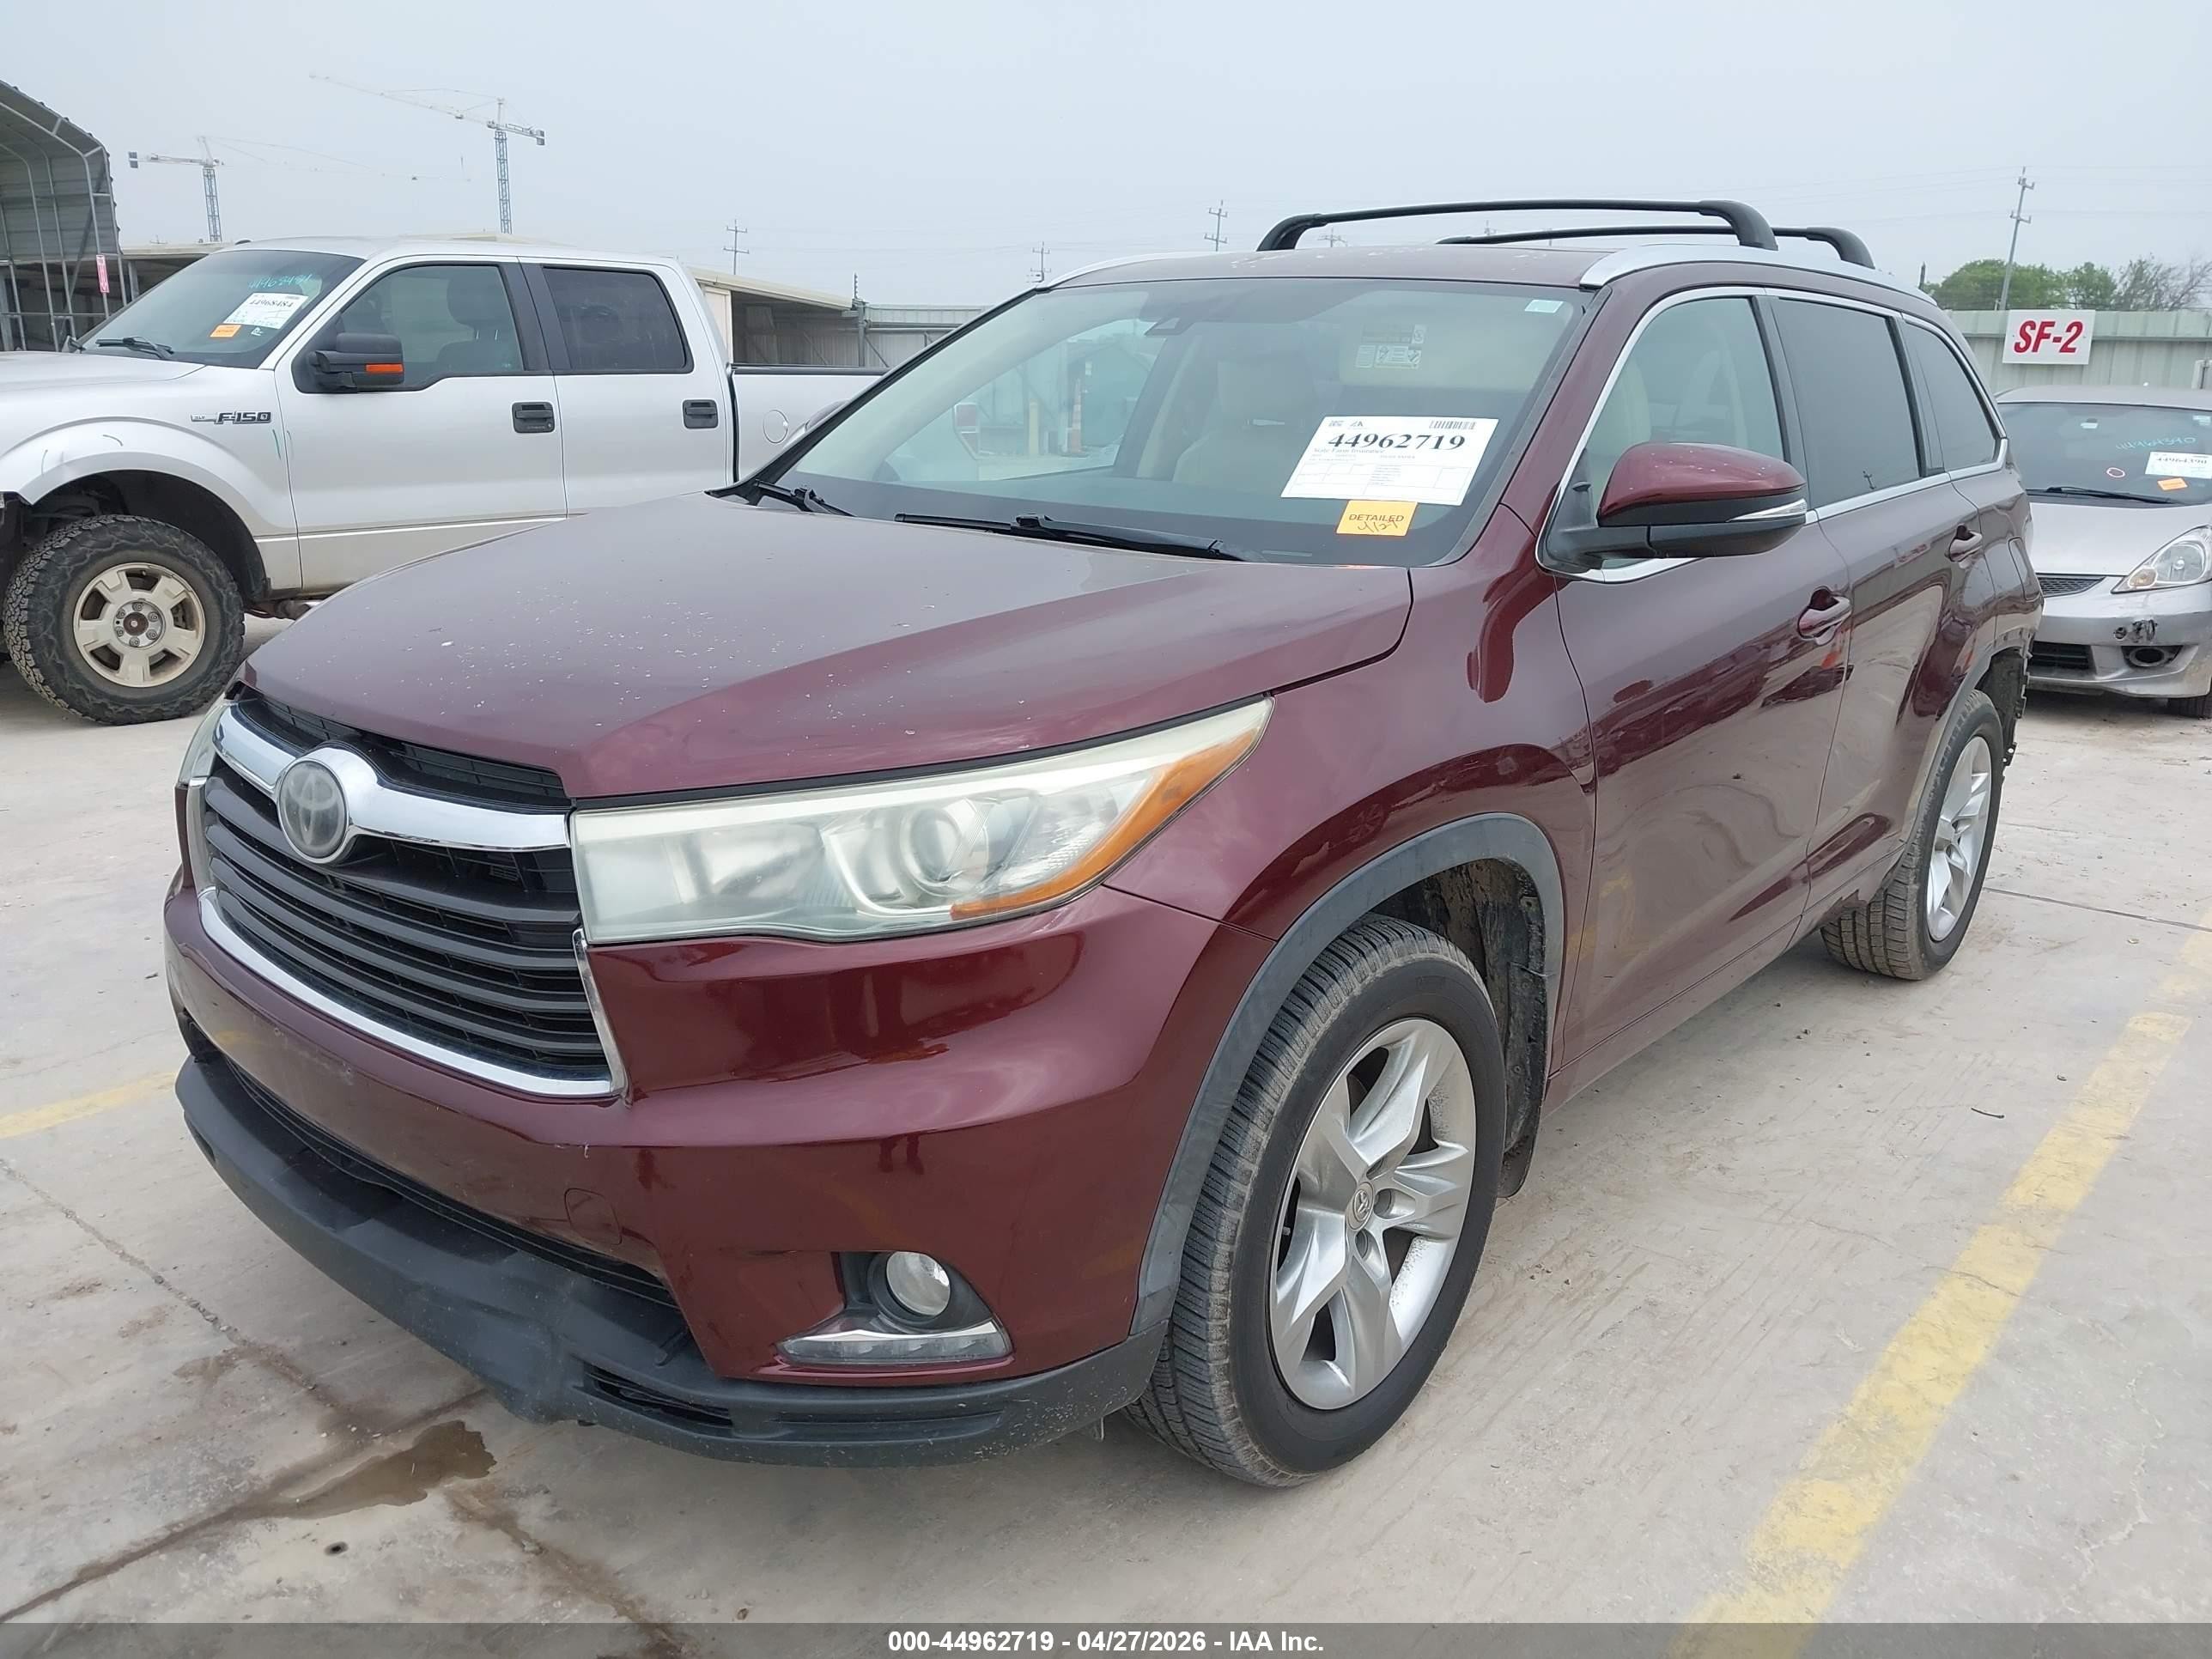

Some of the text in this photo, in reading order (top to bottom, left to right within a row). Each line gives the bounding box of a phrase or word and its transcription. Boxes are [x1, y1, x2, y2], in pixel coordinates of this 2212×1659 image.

[2014, 320, 2083, 353] SF-2
[216, 411, 272, 423] F-150
[1328, 434, 1466, 451] 44962719
[1348, 514, 1405, 522] DETAILED
